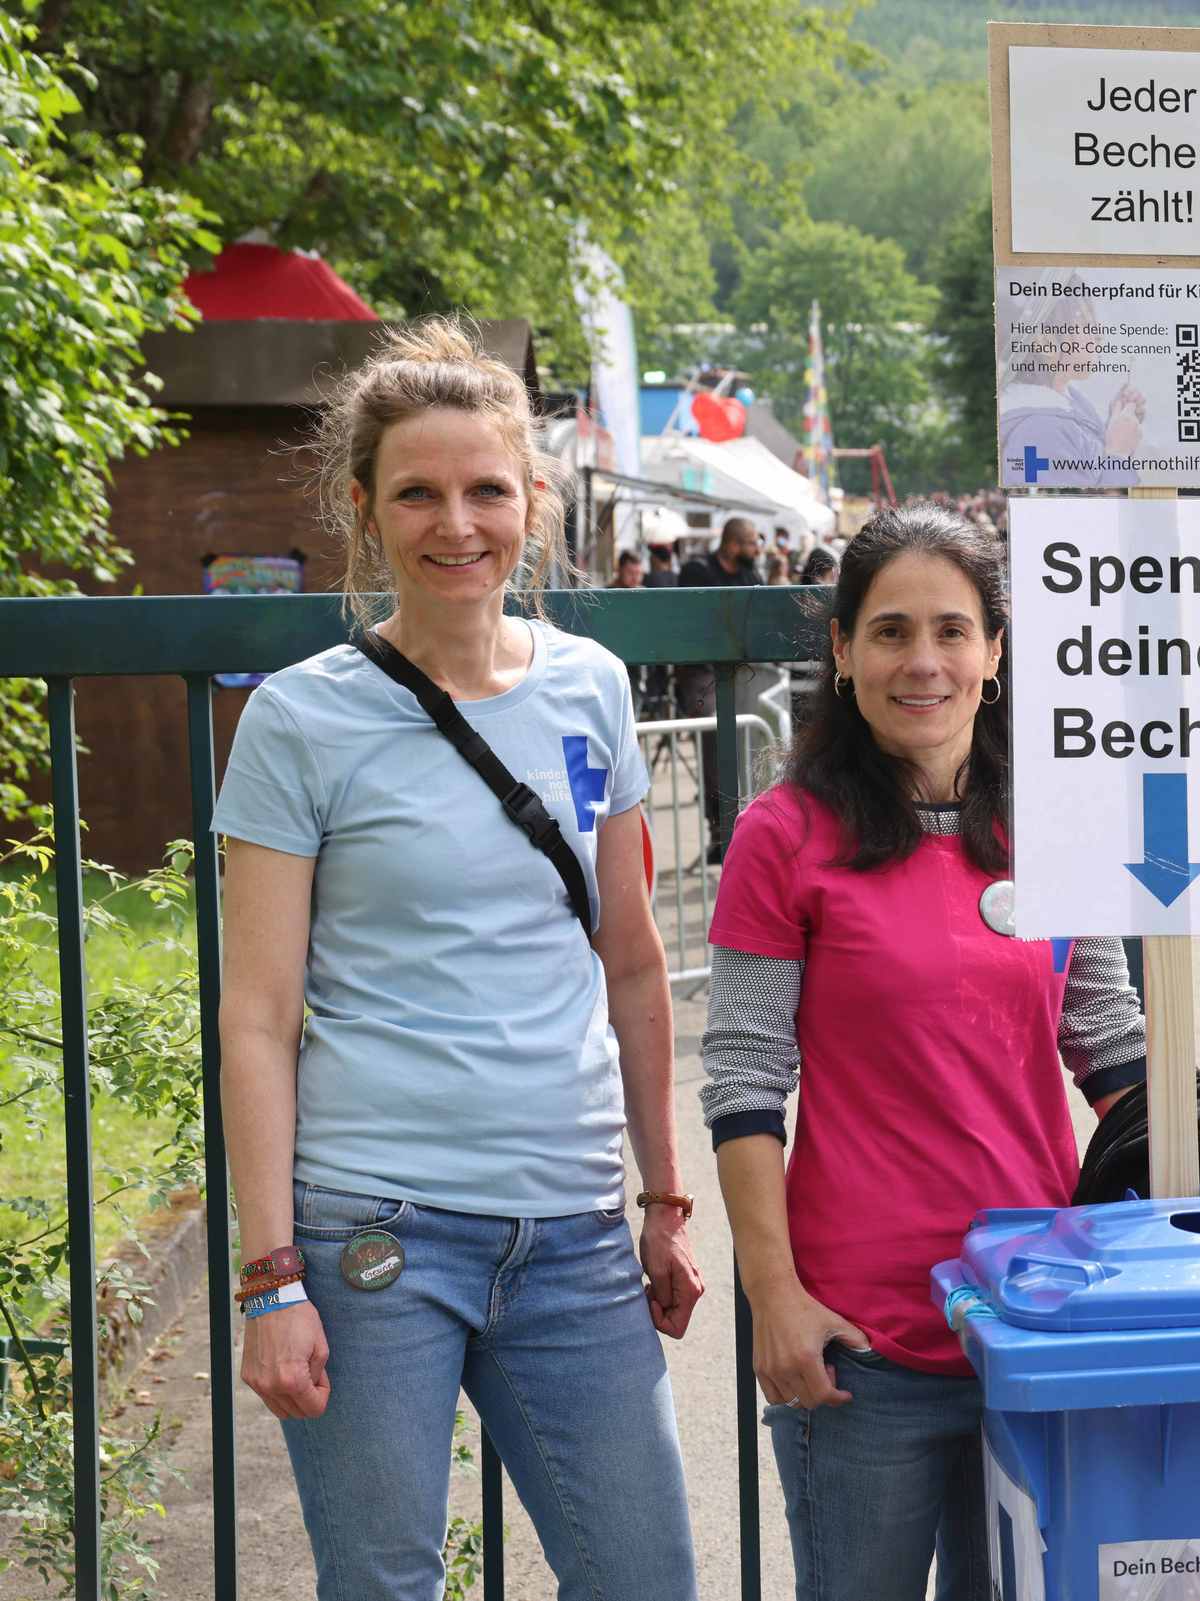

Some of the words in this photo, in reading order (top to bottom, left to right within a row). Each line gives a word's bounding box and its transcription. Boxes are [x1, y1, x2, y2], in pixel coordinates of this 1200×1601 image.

[1087, 78, 1197, 113] Jeder
[1091, 189, 1193, 223] zählt!
[1009, 281, 1047, 297] Dein
[1051, 282, 1154, 300] Becherpfand
[1158, 283, 1182, 298] für
[1011, 323, 1038, 335] Hier
[1041, 323, 1079, 335] landet
[1083, 323, 1117, 335] deine
[1119, 324, 1169, 337] Spende:
[1011, 341, 1057, 354] Einfach
[1060, 341, 1118, 355] QR-Code
[1120, 344, 1171, 355] scannen
[1011, 361, 1036, 373] und
[1038, 361, 1070, 373] mehr
[1072, 361, 1131, 373] erfahren.
[1112, 1559, 1156, 1577] Dein
